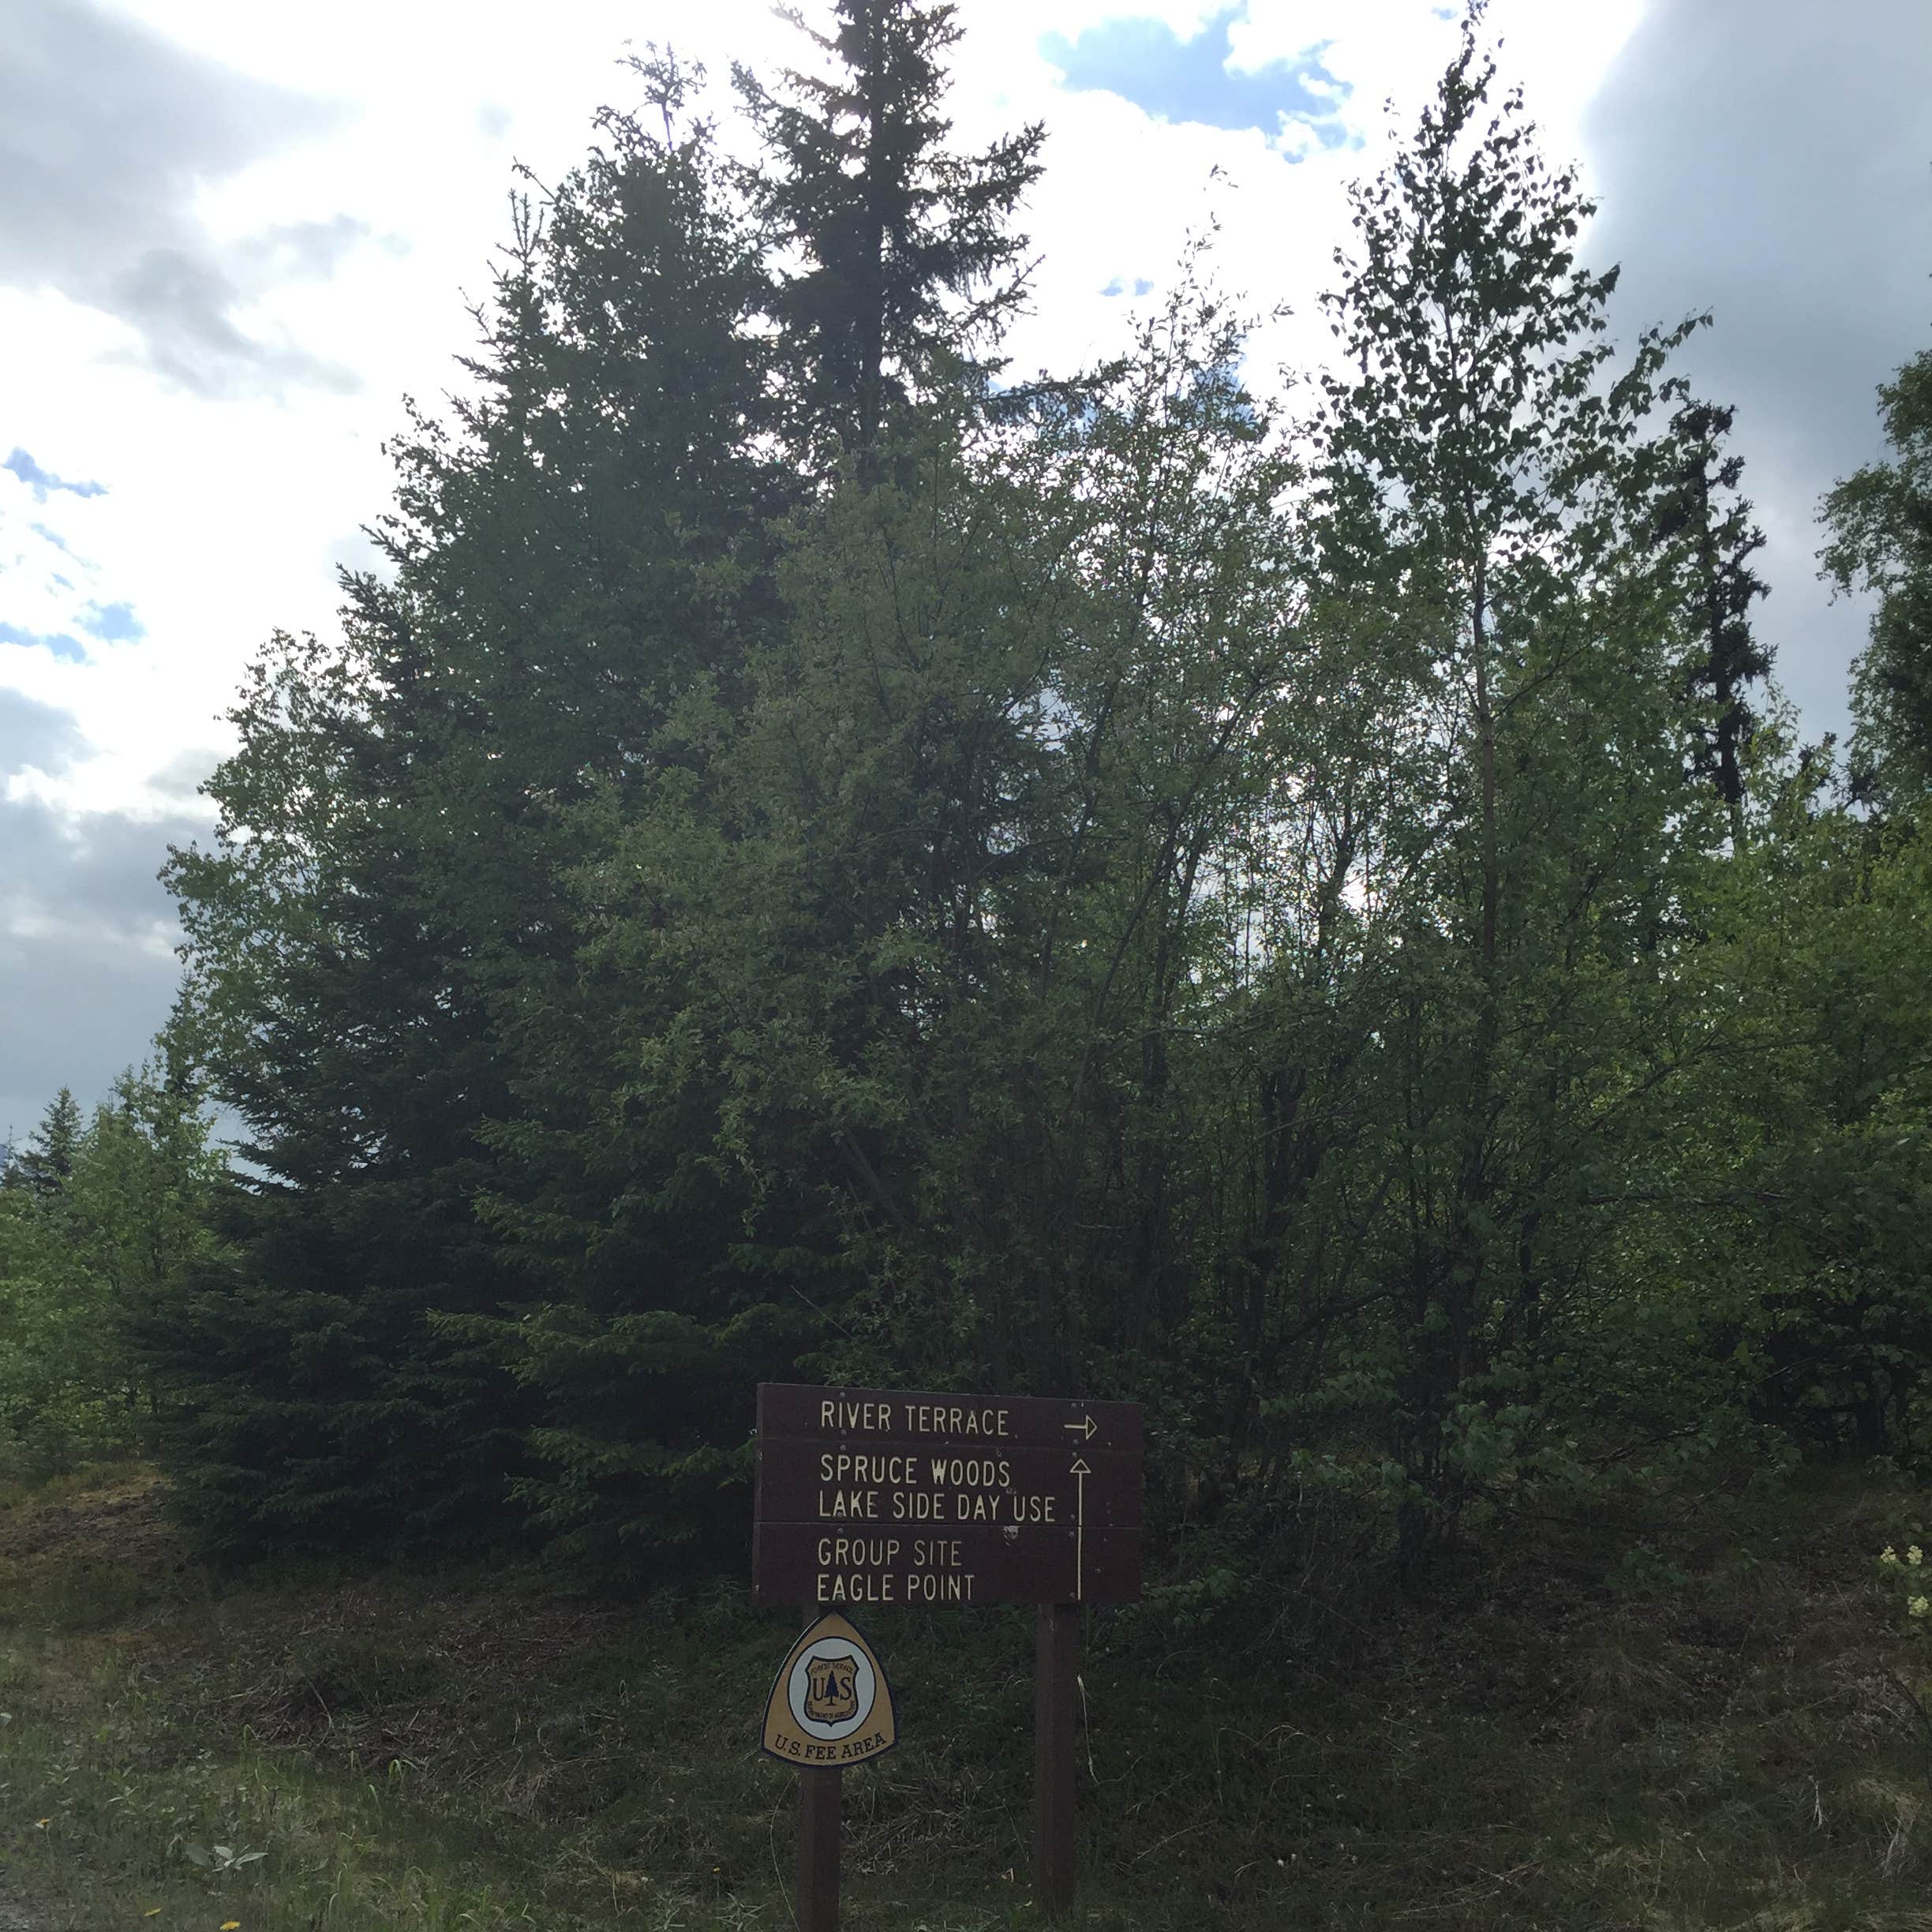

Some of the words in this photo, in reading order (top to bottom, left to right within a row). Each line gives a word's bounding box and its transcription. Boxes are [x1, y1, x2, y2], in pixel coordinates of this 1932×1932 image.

[821, 1401, 891, 1430] RIVER
[904, 1405, 1009, 1436] TERRACE
[820, 1454, 917, 1485] SPRUCE
[931, 1458, 1011, 1487] WOODS
[819, 1490, 878, 1518] LAKE
[893, 1491, 945, 1520] SIDE
[958, 1494, 1001, 1521] DAY
[1013, 1496, 1056, 1522] USE
[818, 1537, 900, 1566] GROUP
[914, 1540, 963, 1567] SITE
[817, 1574, 894, 1601] EAGLE
[907, 1574, 975, 1601] POINT
[804, 1744, 837, 1760] FEE
[841, 1732, 887, 1758] AREA
